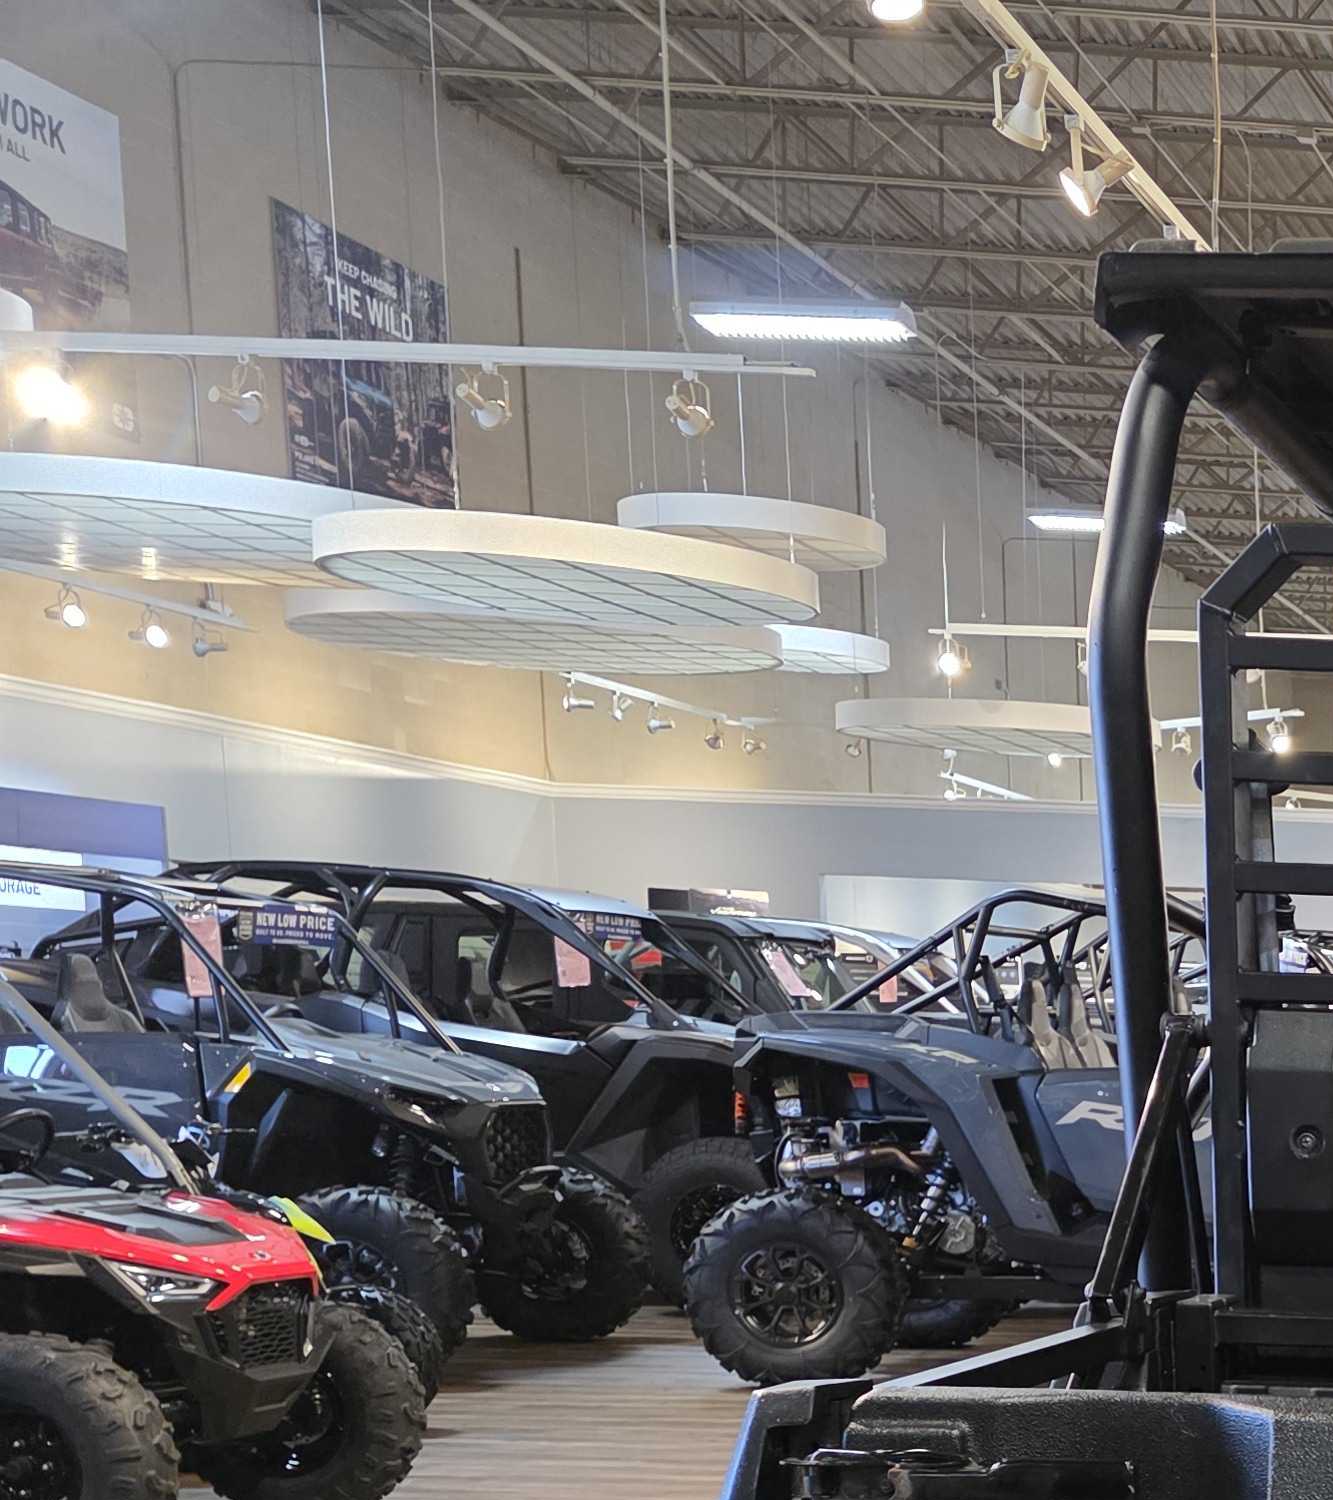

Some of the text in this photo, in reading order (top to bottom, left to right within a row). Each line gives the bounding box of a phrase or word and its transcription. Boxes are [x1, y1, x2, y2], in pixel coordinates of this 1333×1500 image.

[337, 258, 360, 279] KEEP
[323, 274, 414, 342] THE WILD
[0, 879, 41, 896] ORAGE
[256, 912, 276, 927] NEW
[277, 913, 297, 929] LOW
[299, 915, 336, 932] PRICE
